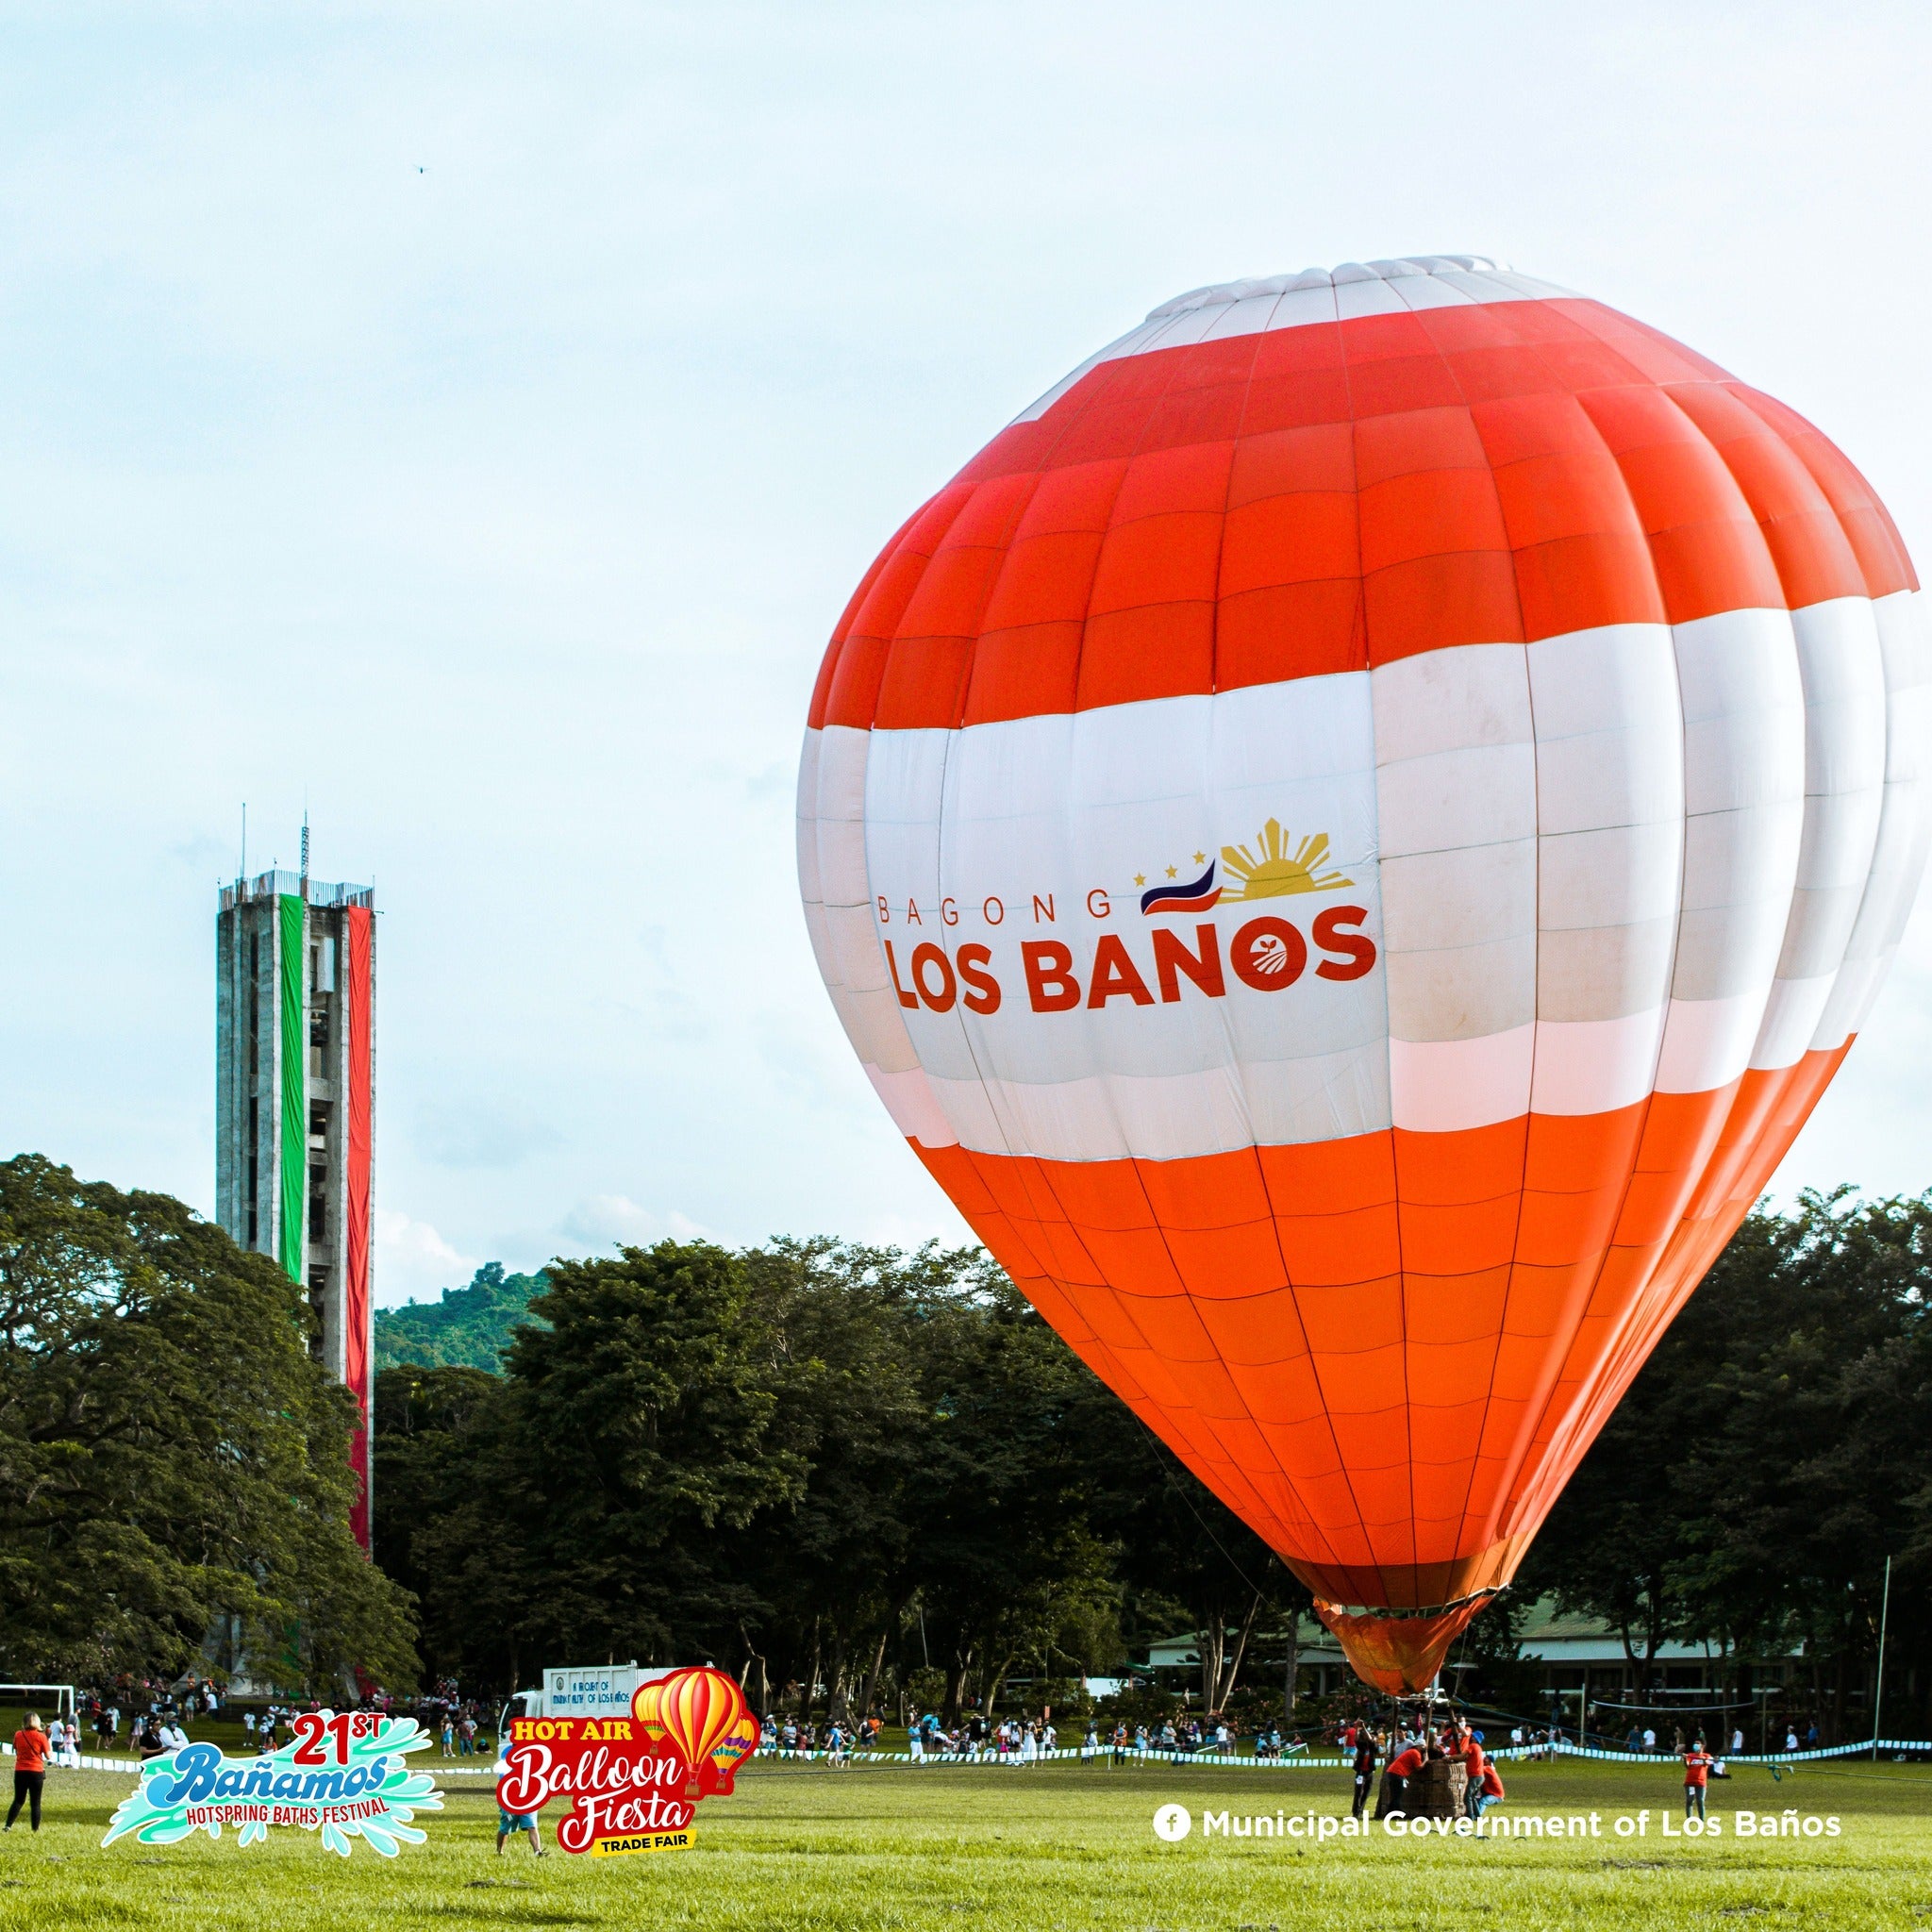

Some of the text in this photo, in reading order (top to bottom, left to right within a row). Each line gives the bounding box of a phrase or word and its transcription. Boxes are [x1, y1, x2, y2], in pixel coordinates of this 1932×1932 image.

[877, 889, 1111, 925] BAGONG
[884, 939, 1001, 1015] LOS
[601, 1681, 608, 1690] OF
[588, 1693, 595, 1703] OF
[598, 1692, 609, 1703] LOS
